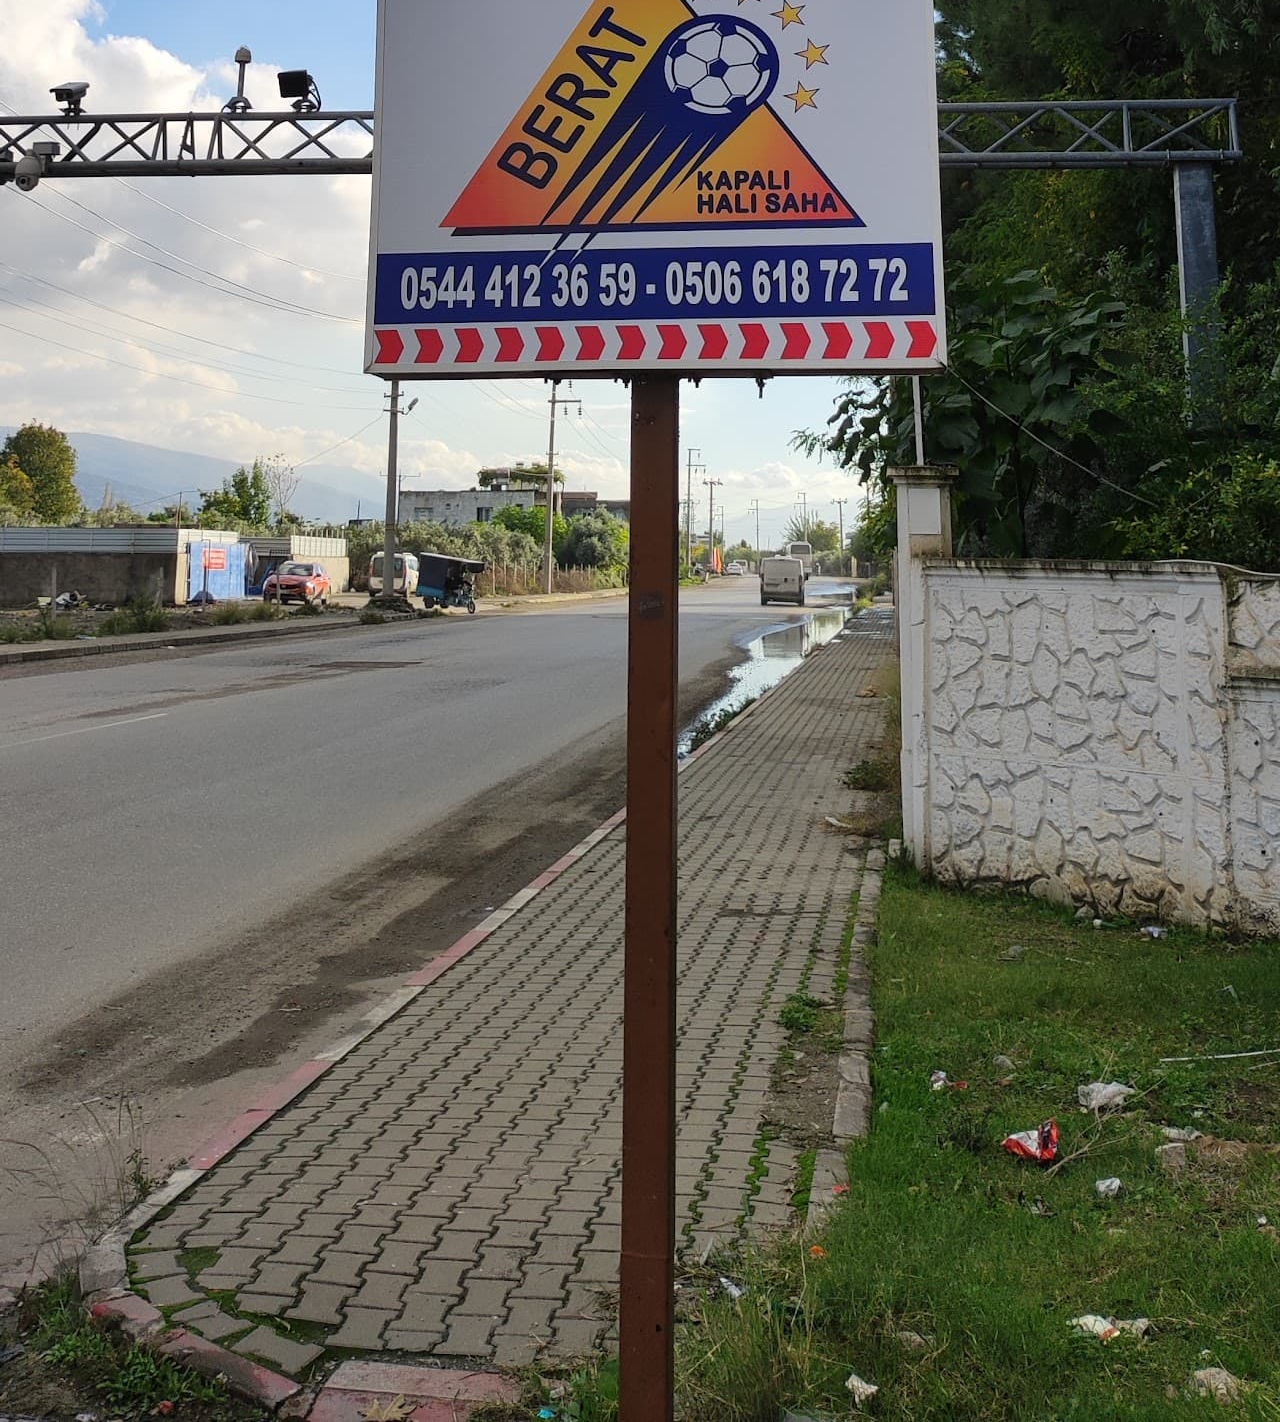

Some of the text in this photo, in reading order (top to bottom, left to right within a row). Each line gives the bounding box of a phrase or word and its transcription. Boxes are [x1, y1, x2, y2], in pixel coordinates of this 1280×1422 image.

[496, 6, 647, 190] BERAT
[697, 169, 790, 191] KAPALI
[697, 192, 838, 214] HALI SAHA
[400, 257, 909, 310] 0544 412 36 59 - 0506 618 72 72
